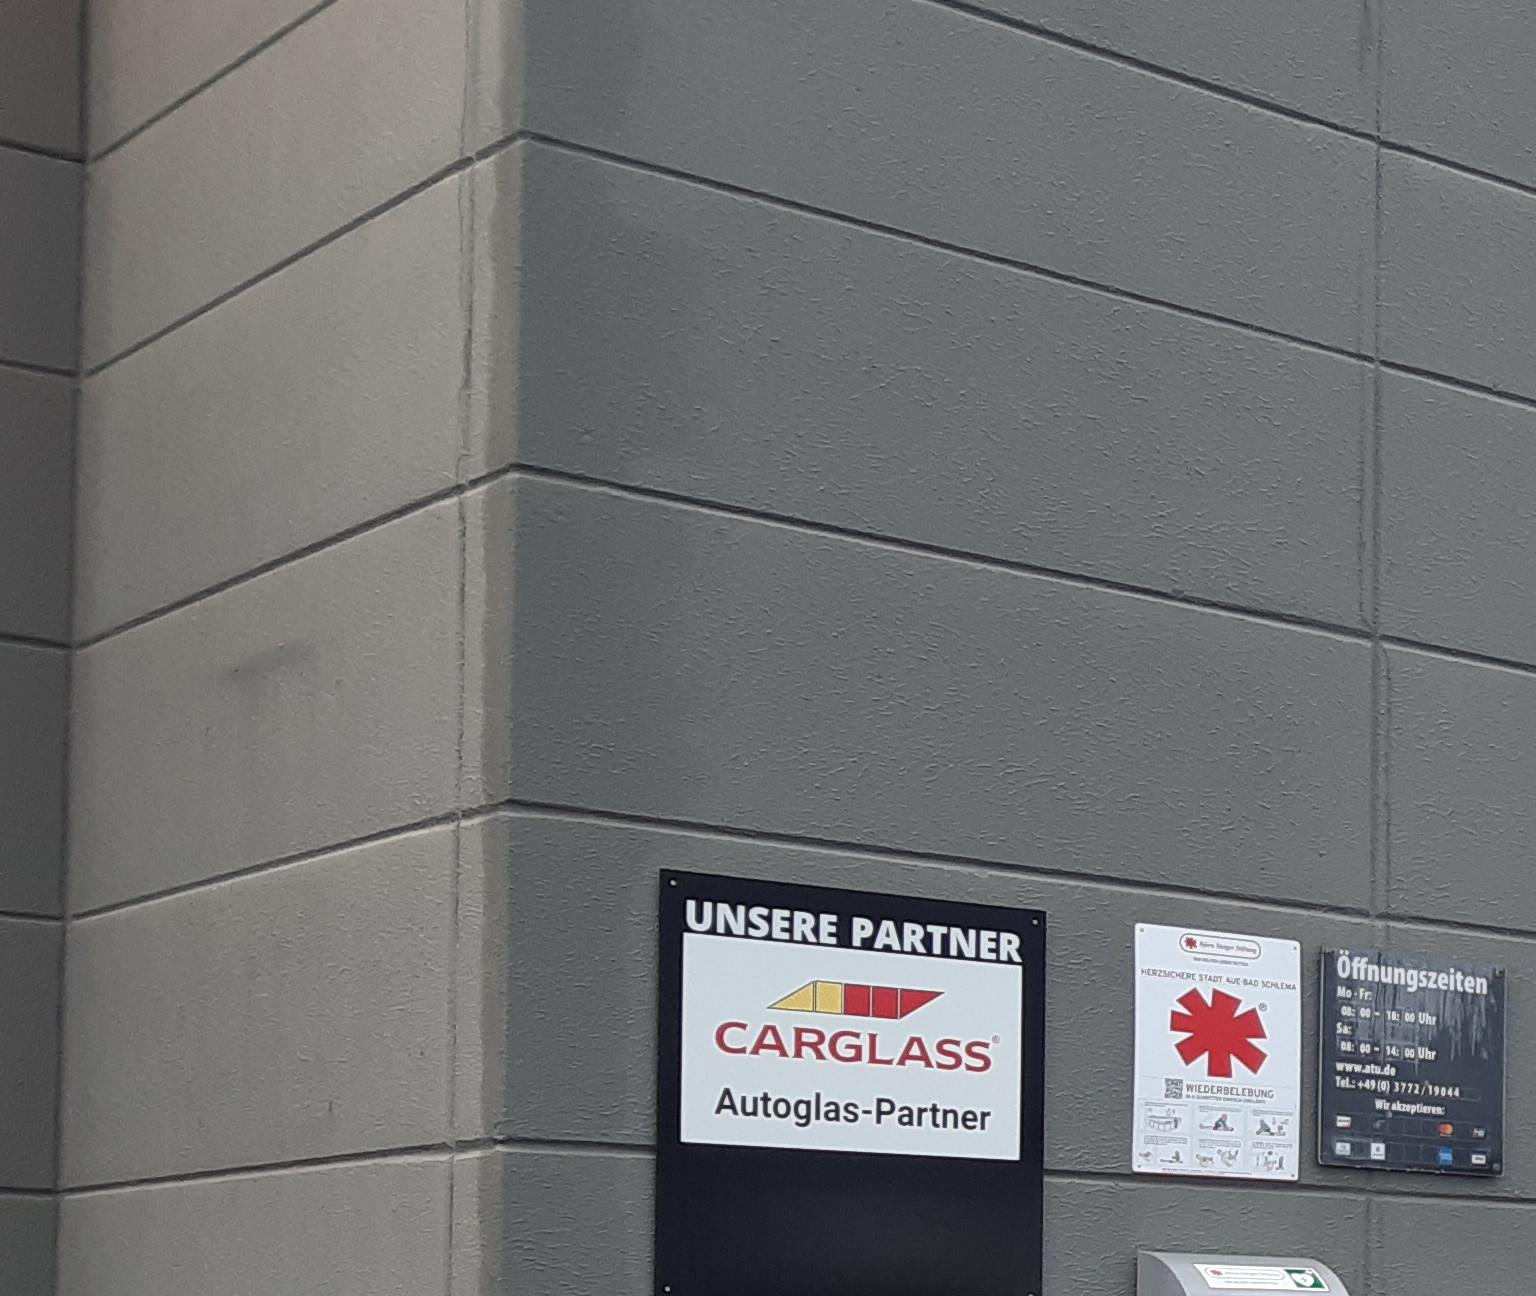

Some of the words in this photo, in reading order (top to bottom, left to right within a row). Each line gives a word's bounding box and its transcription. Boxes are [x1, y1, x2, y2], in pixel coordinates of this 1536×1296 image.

[685, 899, 837, 945] UNSERE
[851, 916, 1023, 963] PARTNER
[1336, 949, 1489, 995] Öffnungszeiten
[1418, 1012, 1437, 1026] Uhr
[714, 1021, 993, 1073] CARGLASS
[1418, 1047, 1437, 1061] Uhr
[1335, 1062, 1397, 1077] www.atu.de
[1185, 1083, 1275, 1099] WIEDERBELEBUNG
[714, 1087, 992, 1131] Autoglas-Partner
